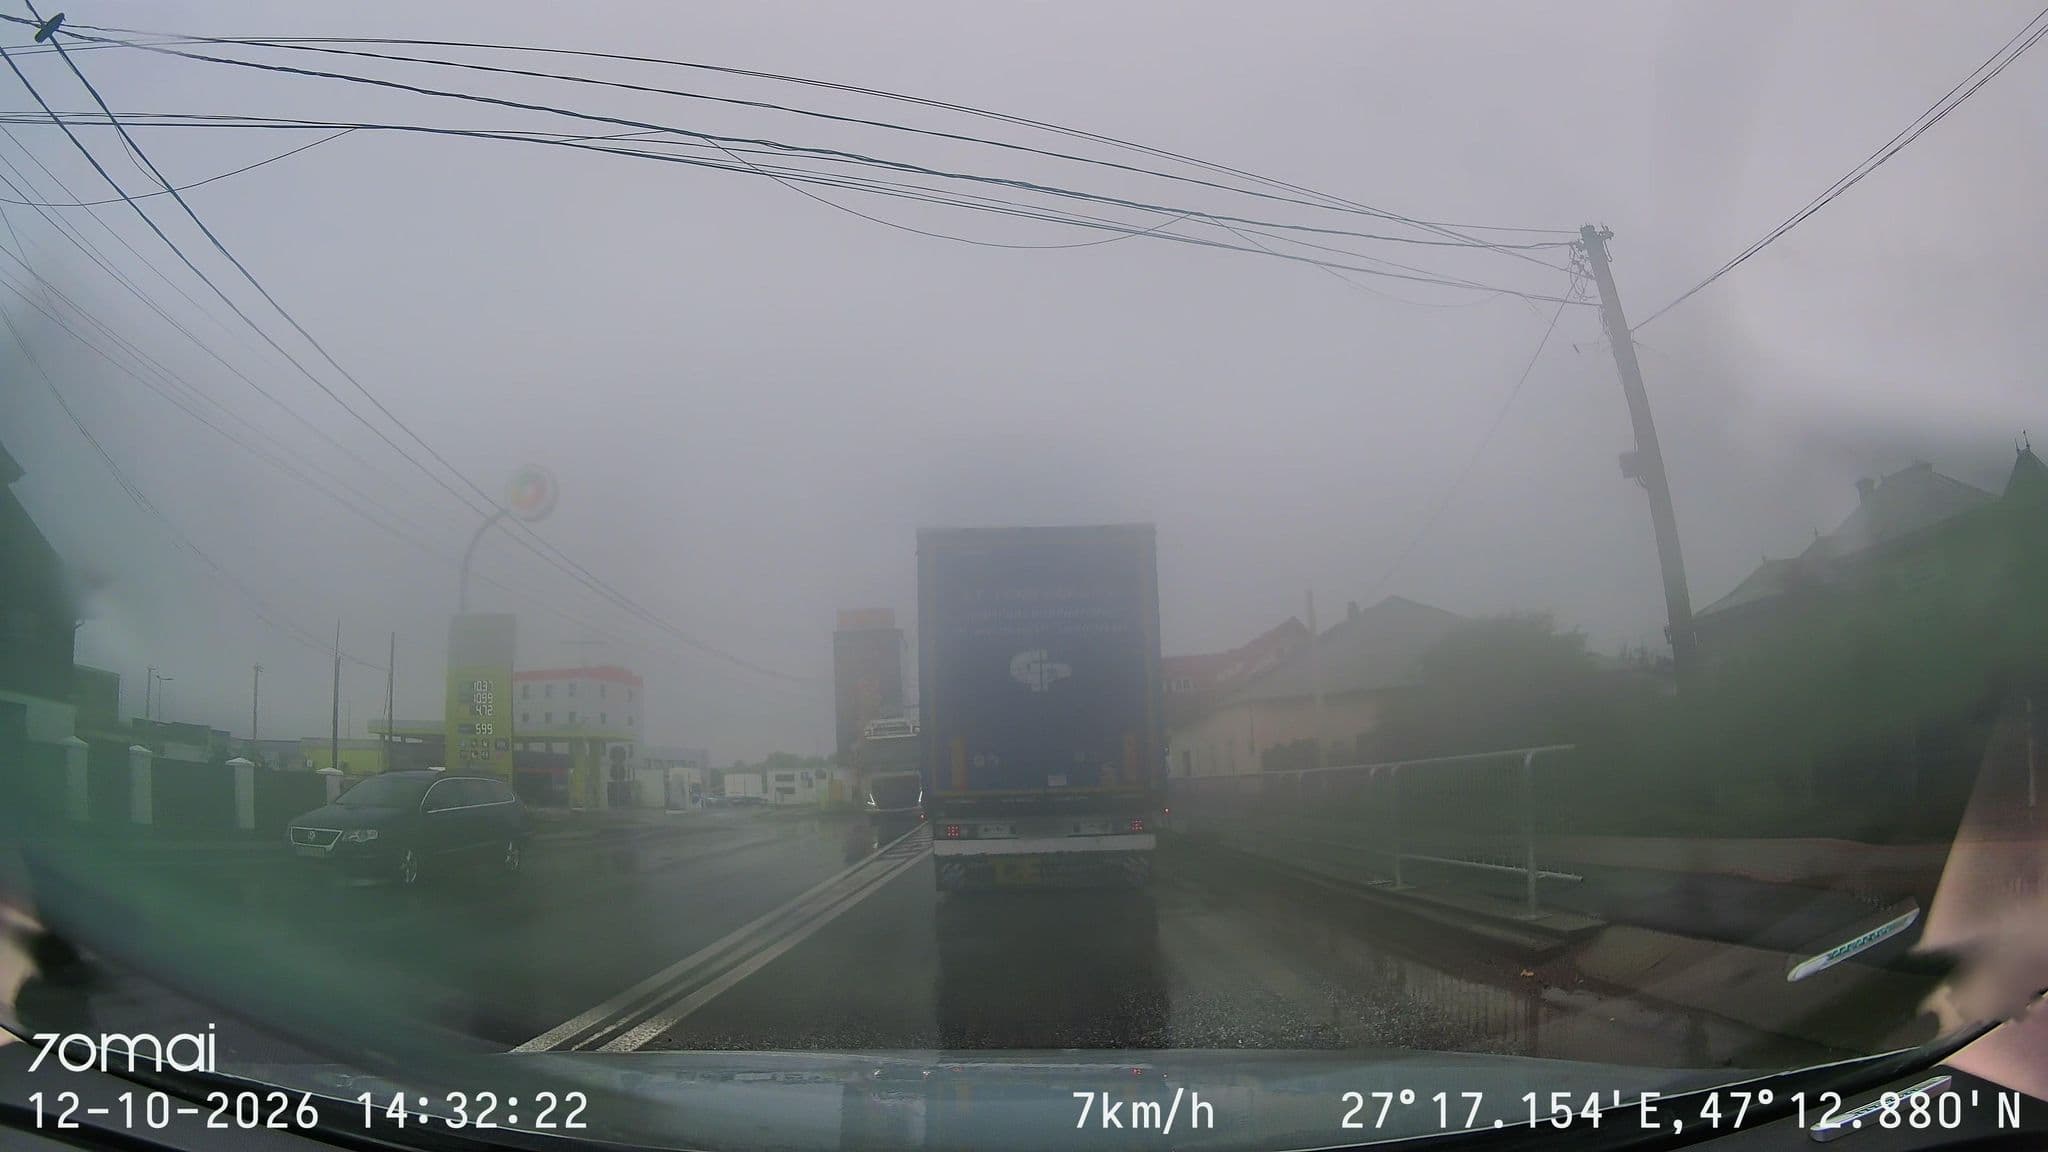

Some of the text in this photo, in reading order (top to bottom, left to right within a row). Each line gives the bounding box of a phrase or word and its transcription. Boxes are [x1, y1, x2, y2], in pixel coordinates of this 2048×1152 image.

[473, 693, 494, 704] 1099
[475, 705, 494, 716] 472
[475, 723, 493, 735] 599
